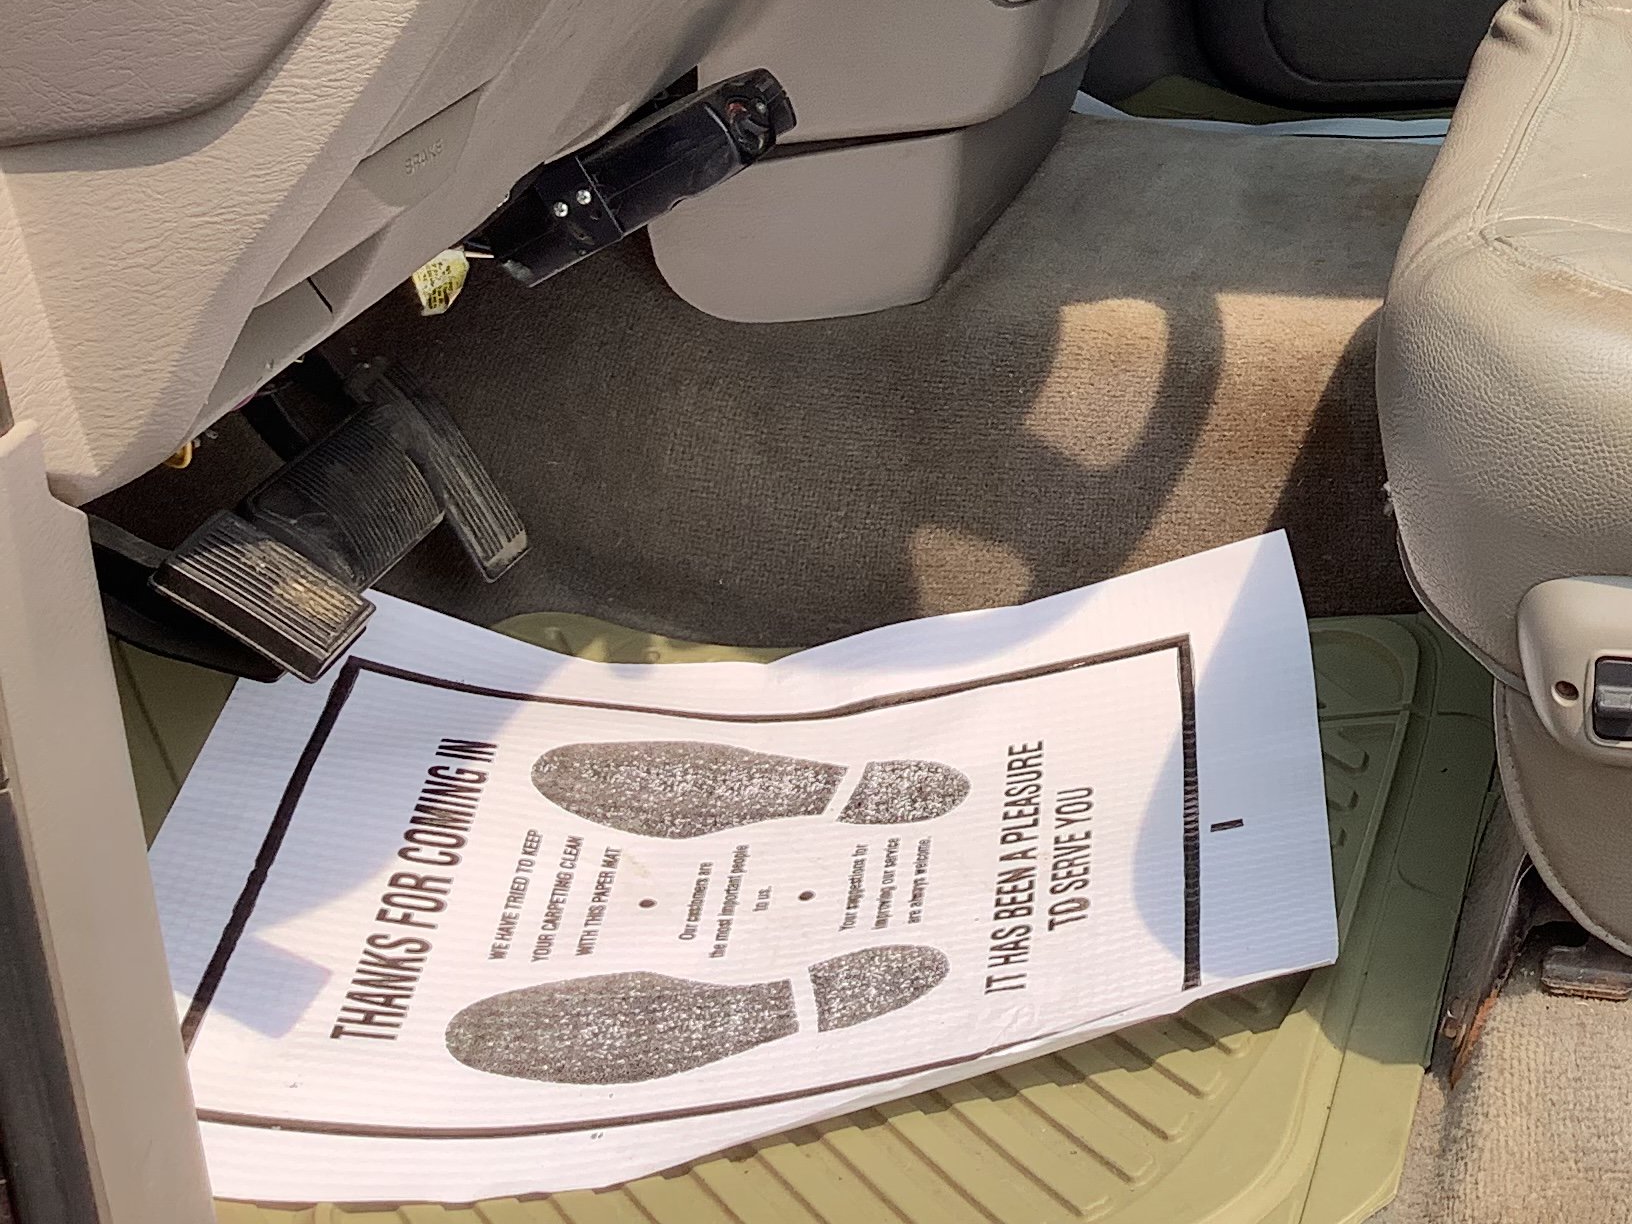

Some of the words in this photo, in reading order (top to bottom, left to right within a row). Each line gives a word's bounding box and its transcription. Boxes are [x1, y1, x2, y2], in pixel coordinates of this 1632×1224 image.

[435, 738, 498, 763] IN
[1000, 740, 1043, 845] PLEASURE
[397, 765, 488, 866] COMING
[1055, 787, 1094, 828] YOU
[521, 829, 542, 856] KEEP
[560, 836, 583, 869] CLEAN
[851, 844, 868, 857] for
[884, 838, 900, 868] service
[999, 847, 1038, 862] A
[515, 858, 535, 873] TO
[601, 847, 621, 869] MAT
[698, 862, 713, 875] are
[730, 845, 750, 873] people
[1049, 831, 1091, 894] SERVE
[592, 871, 615, 903] PAPER
[846, 859, 866, 910] suggestions
[881, 870, 895, 885] our
[375, 872, 453, 929] FOR
[504, 877, 530, 910] TRIED
[540, 872, 574, 931] CARPETING
[687, 878, 708, 922] customers
[717, 875, 741, 916] important
[908, 878, 928, 907] always
[993, 866, 1036, 920] BEEN
[584, 906, 606, 928] THIS
[752, 902, 769, 912] to
[871, 887, 896, 930] improving
[907, 910, 921, 924] are
[1048, 897, 1090, 931] TO
[495, 913, 519, 941] HAVE
[678, 924, 698, 940] Our
[715, 919, 732, 941] most
[838, 912, 857, 931] Your
[488, 943, 510, 960] WE
[530, 934, 554, 962] YOUR
[576, 930, 599, 956] WITH
[709, 944, 726, 958] the
[987, 925, 1032, 968] HAS
[330, 934, 432, 1040] THANKS
[984, 973, 1026, 995] IT
